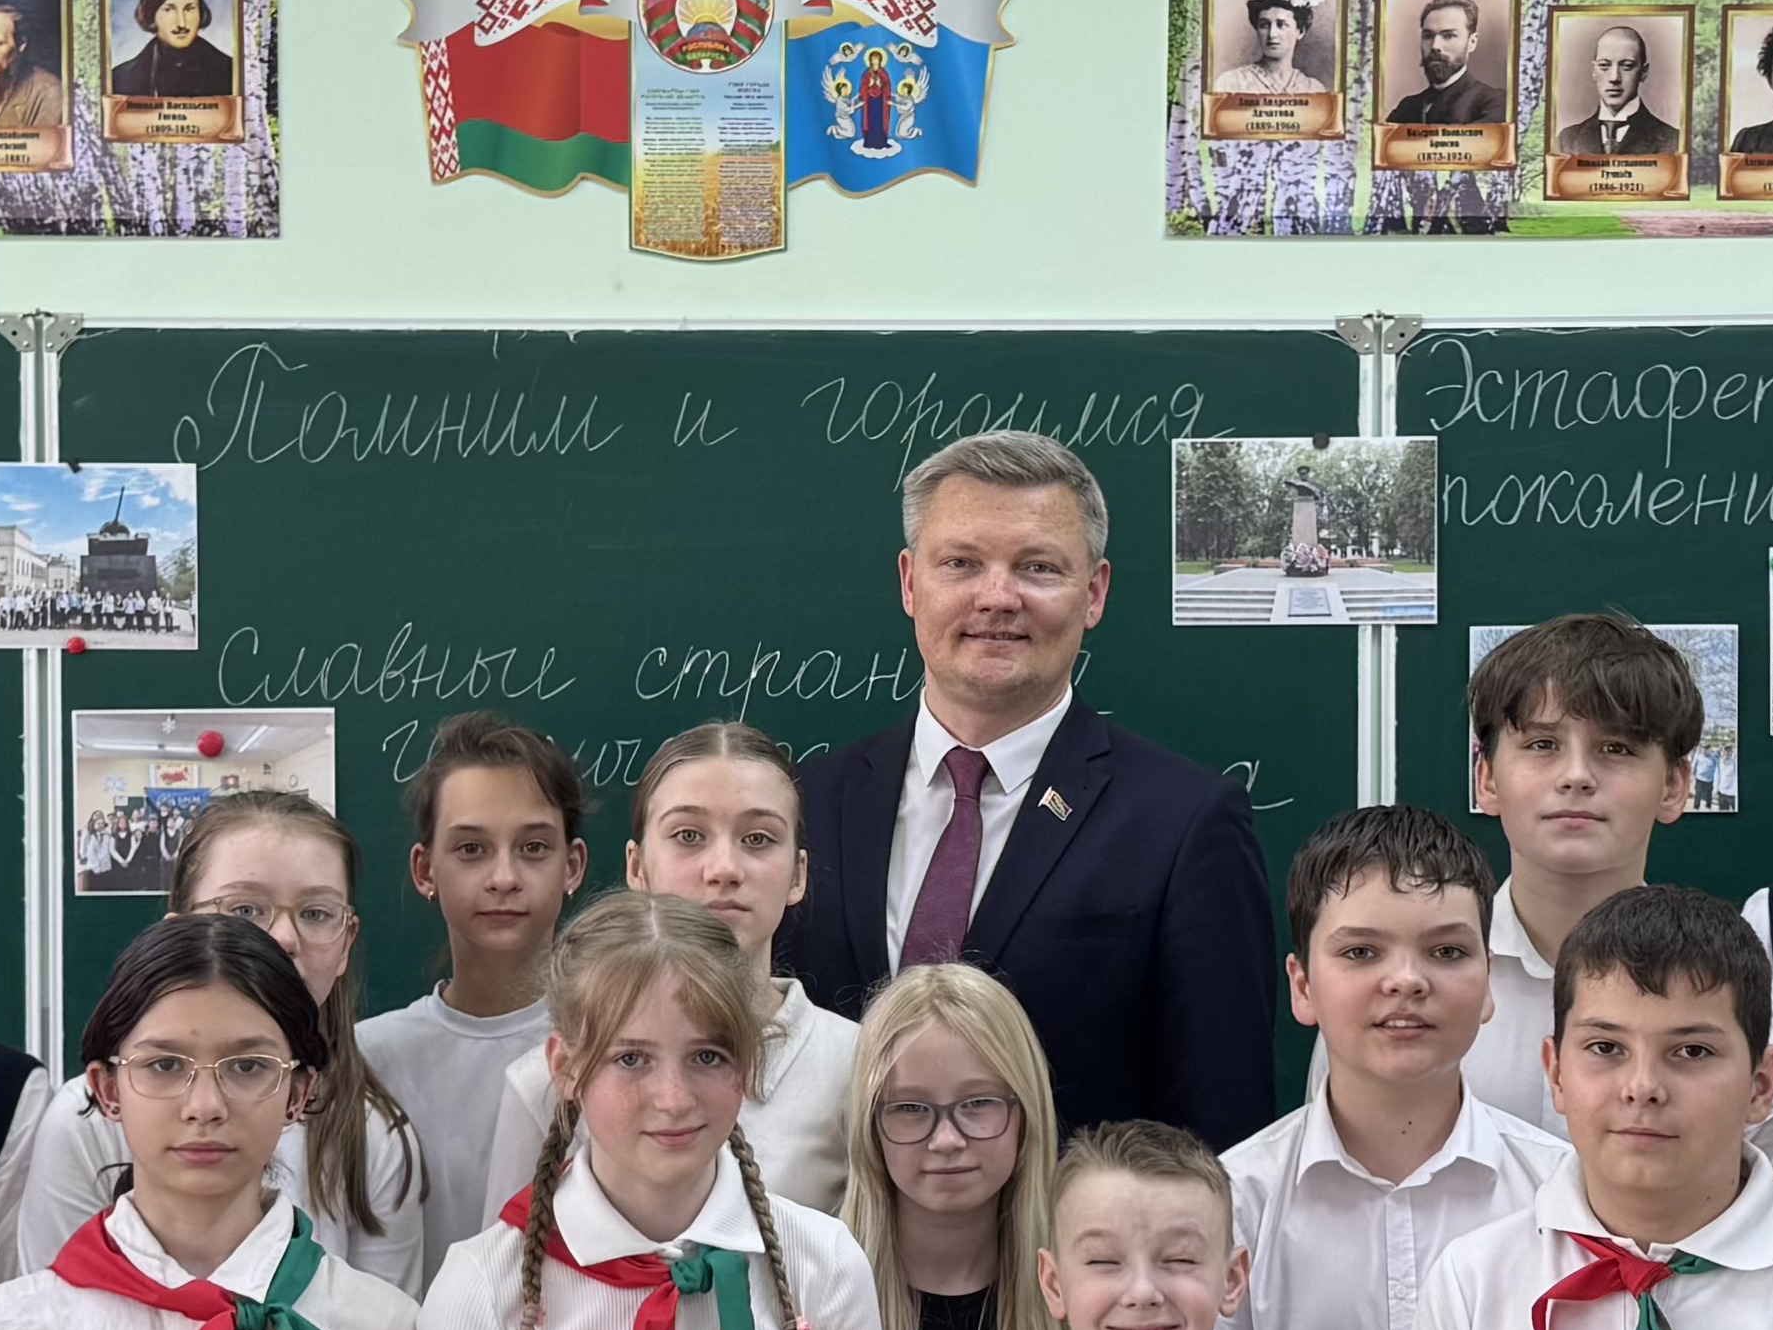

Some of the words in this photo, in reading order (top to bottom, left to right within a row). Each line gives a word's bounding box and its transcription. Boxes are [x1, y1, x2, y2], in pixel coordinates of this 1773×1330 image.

[1245, 122, 1301, 133] (1889-1966)
[1416, 151, 1472, 162] (1873-1924)
[1589, 181, 1645, 193] (1886-1921)
[172, 341, 625, 472] Помним
[673, 392, 739, 447] и
[217, 621, 578, 707] Славные
